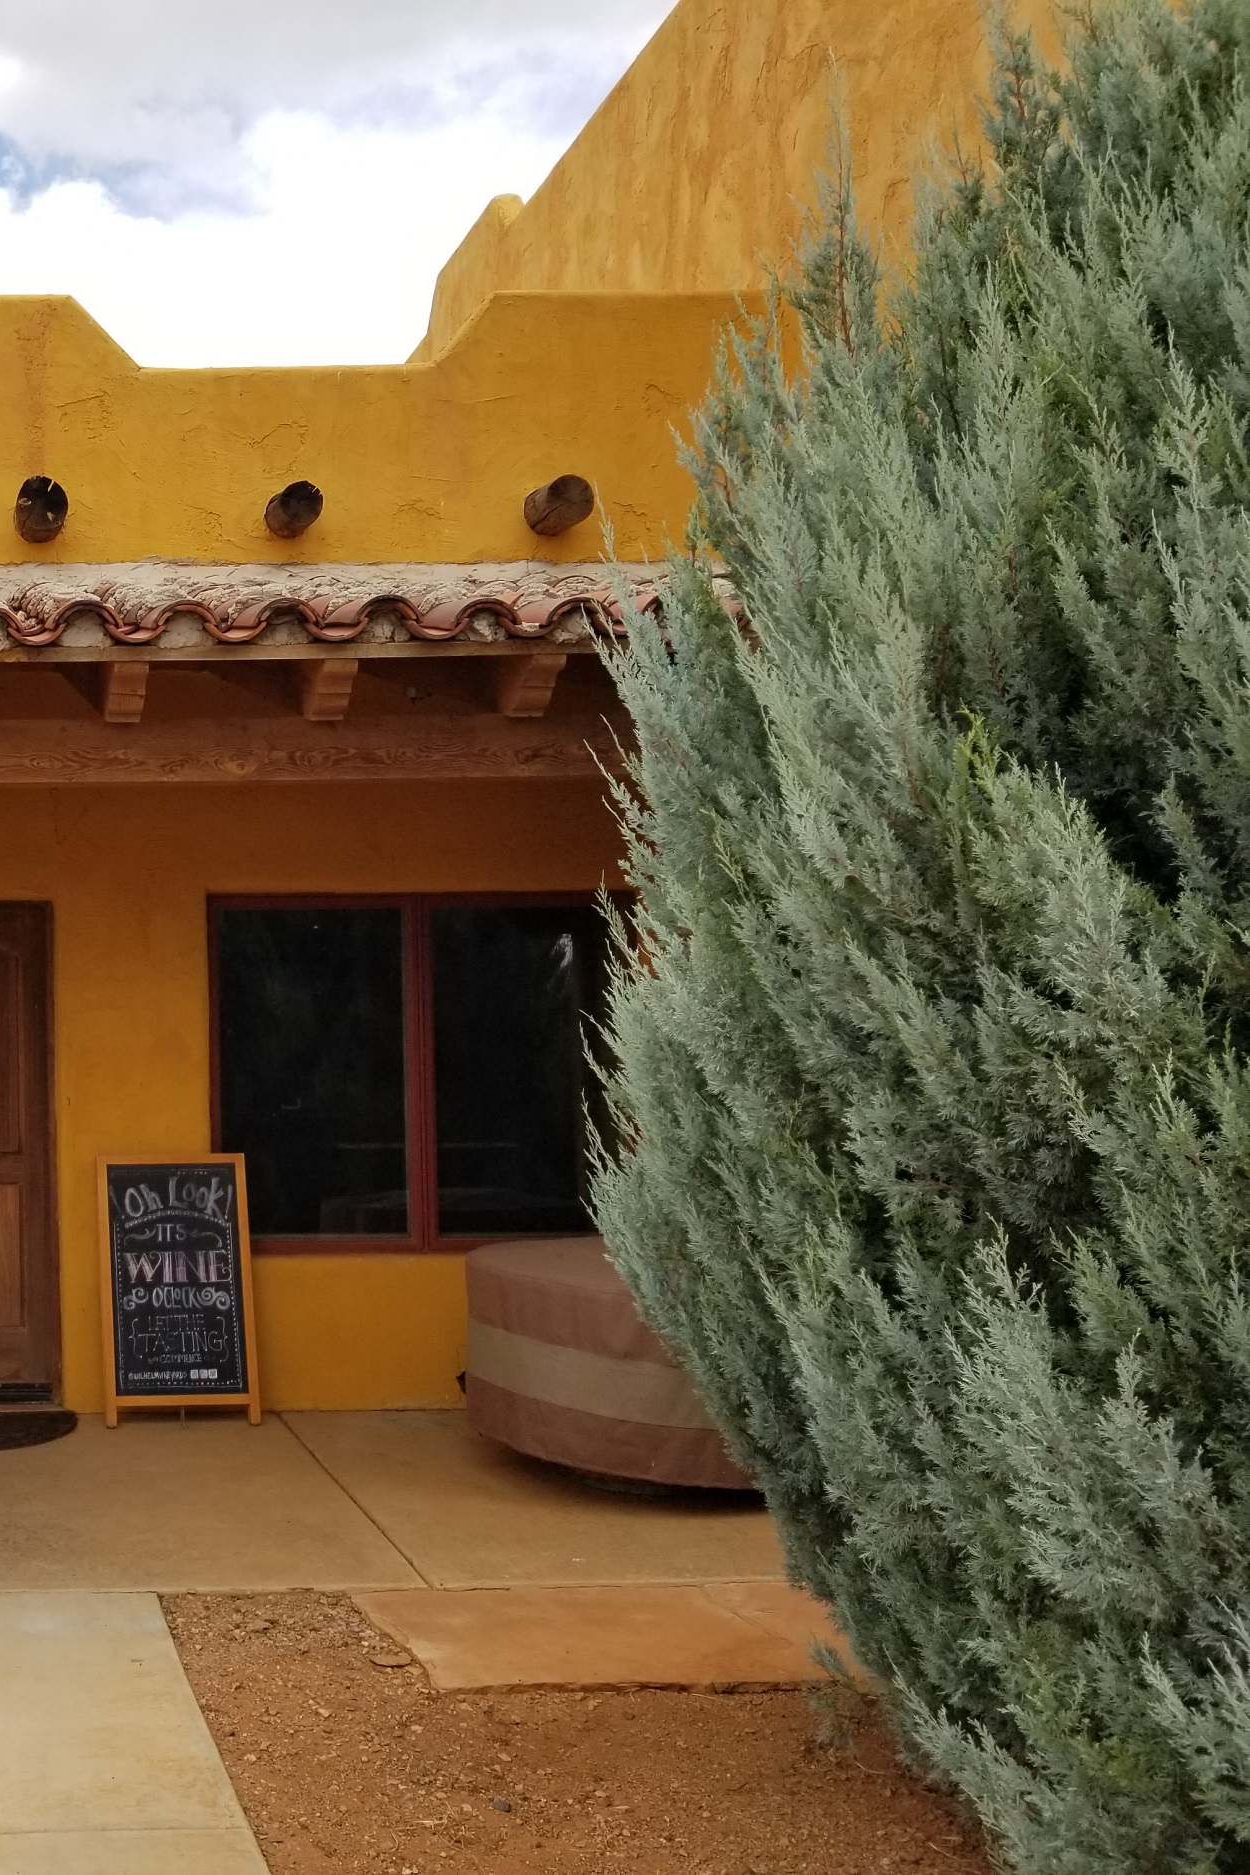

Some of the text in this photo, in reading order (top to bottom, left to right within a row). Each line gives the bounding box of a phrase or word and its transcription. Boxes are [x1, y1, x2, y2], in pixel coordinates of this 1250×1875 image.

[123, 1250, 232, 1284] WINE
[148, 1313, 204, 1331] LET THE
[138, 1331, 223, 1352] TASTING
[160, 1353, 203, 1364] COMMENCE
